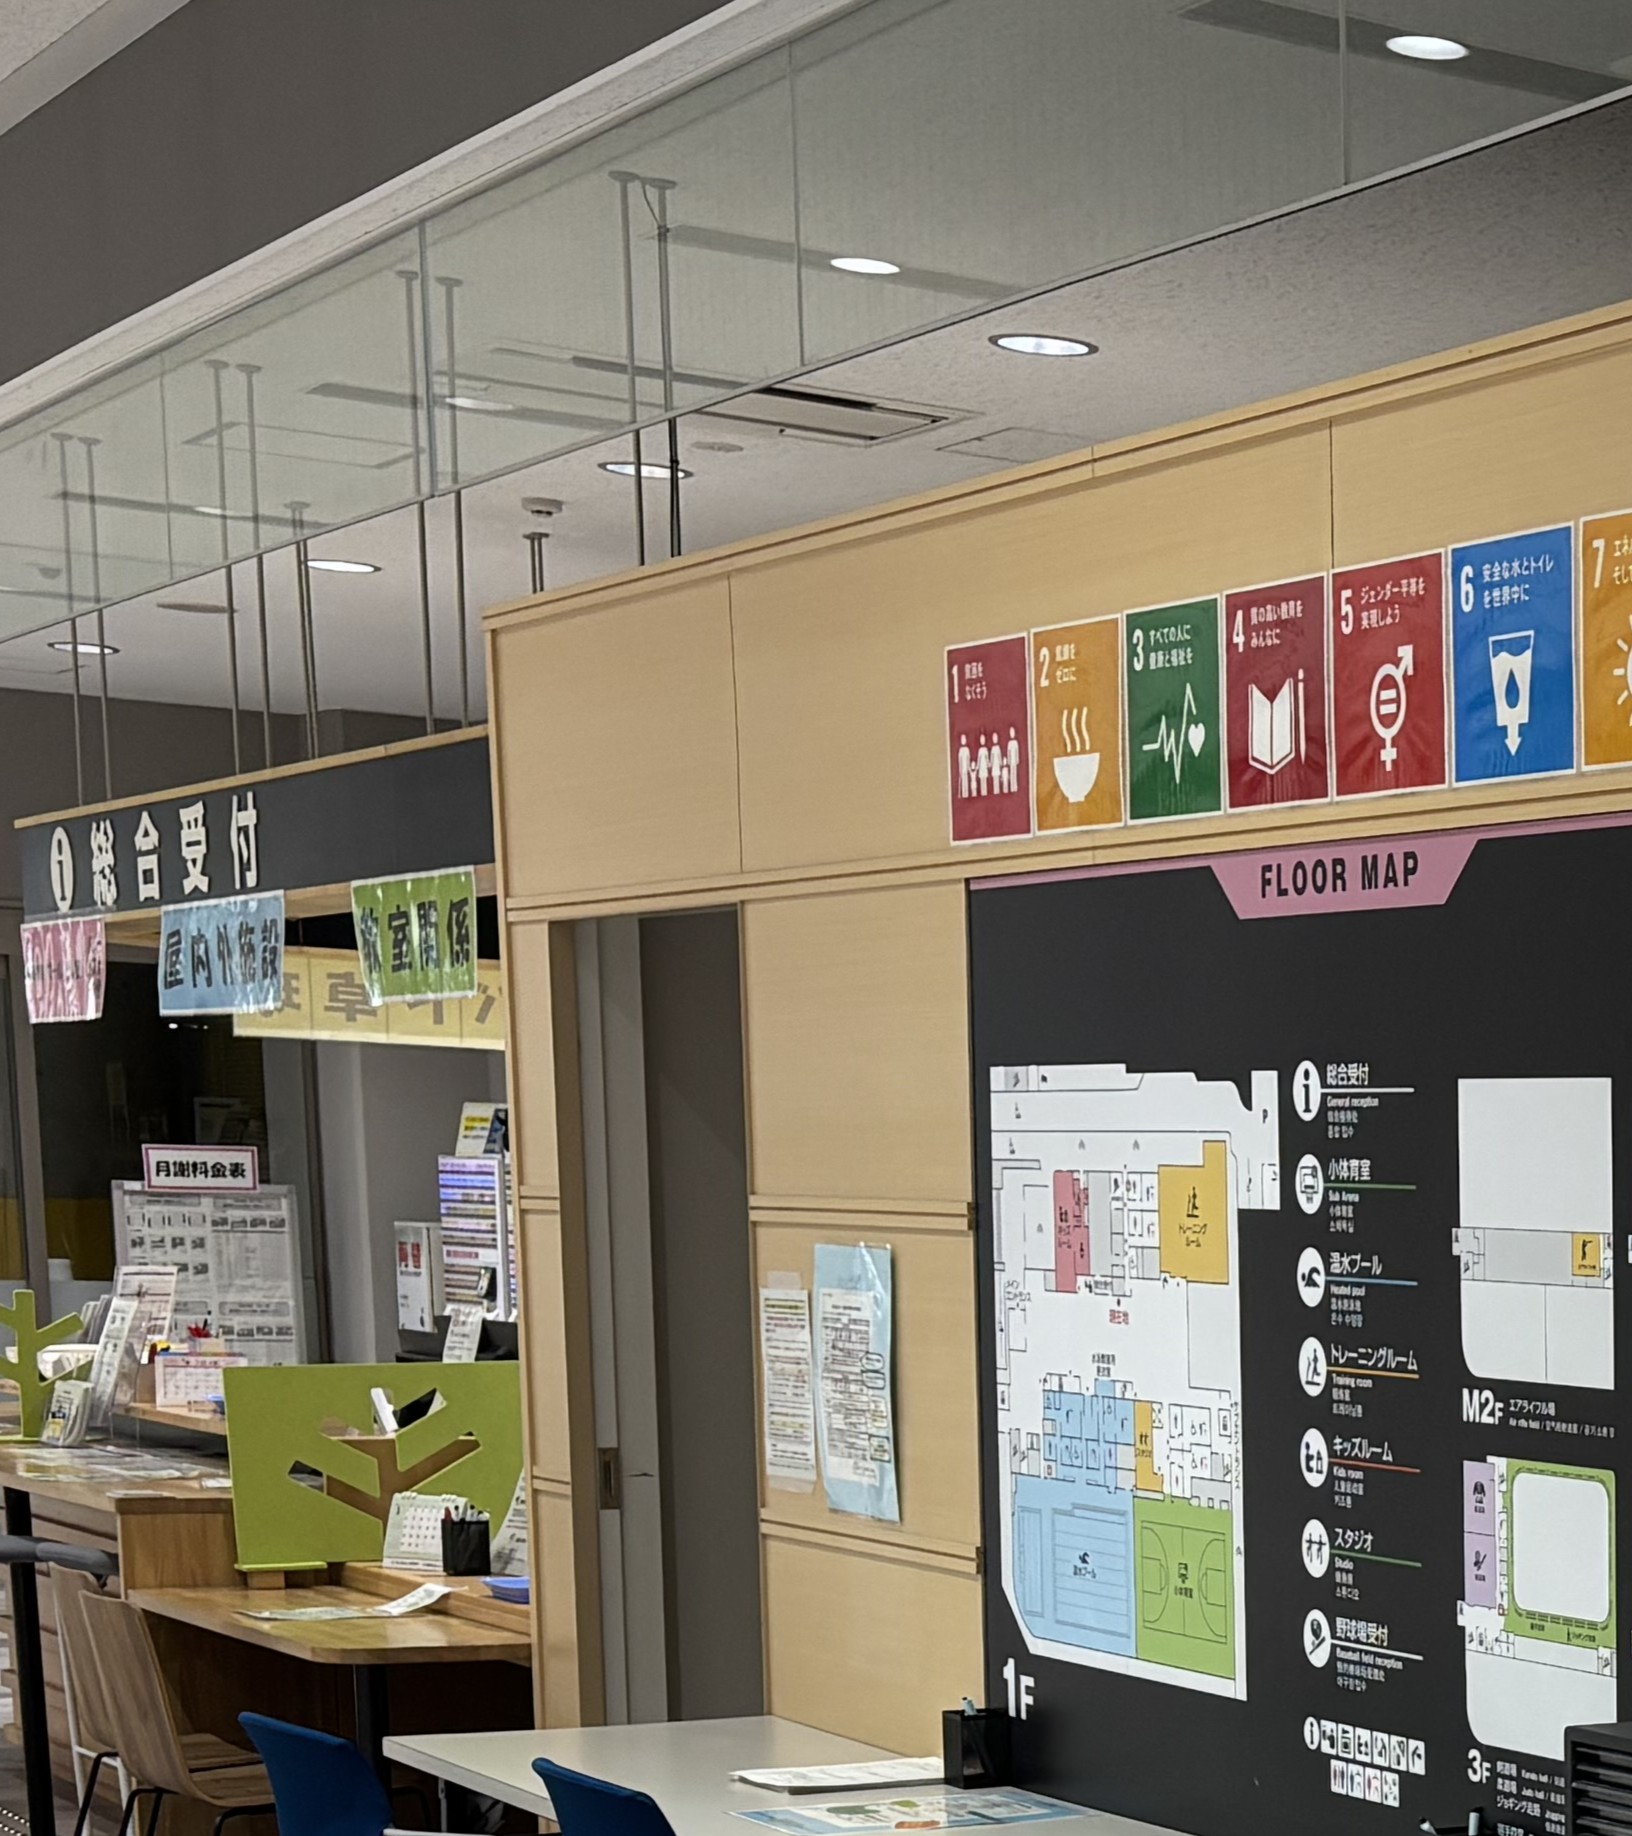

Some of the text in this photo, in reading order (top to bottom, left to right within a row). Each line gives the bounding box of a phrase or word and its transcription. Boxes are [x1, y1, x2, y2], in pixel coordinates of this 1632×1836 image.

[1481, 554, 1554, 582] 安全な水とトイレ
[1591, 537, 1605, 589] 7
[1359, 576, 1426, 604] ジェンダー平等を
[1459, 566, 1475, 613] 6
[1482, 582, 1531, 608] を世界中に
[1339, 588, 1353, 635] 5
[1360, 604, 1401, 631] 実現しよう
[1148, 624, 1192, 644] すべての人に
[1231, 609, 1245, 652] 4
[1132, 629, 1144, 671] 3
[1039, 646, 1050, 687] 2
[950, 664, 959, 702] 1
[90, 791, 258, 907] 総合受付
[1260, 851, 1419, 898] FLOOR MAP
[1327, 1064, 1368, 1085] 総合受付
[155, 1161, 247, 1181] 月謝料金表
[1328, 1159, 1371, 1180] 小体育室
[1330, 1252, 1382, 1275] 温水プール
[1330, 1343, 1417, 1370] トレーニングルーム
[1462, 1388, 1504, 1425] M2F
[1333, 1436, 1393, 1462] キッズルーム
[1334, 1529, 1374, 1551] スタジオ
[1336, 1617, 1388, 1646] 野球場受付
[1002, 1658, 1035, 1720] 1F
[1467, 1748, 1491, 1785] 3F
